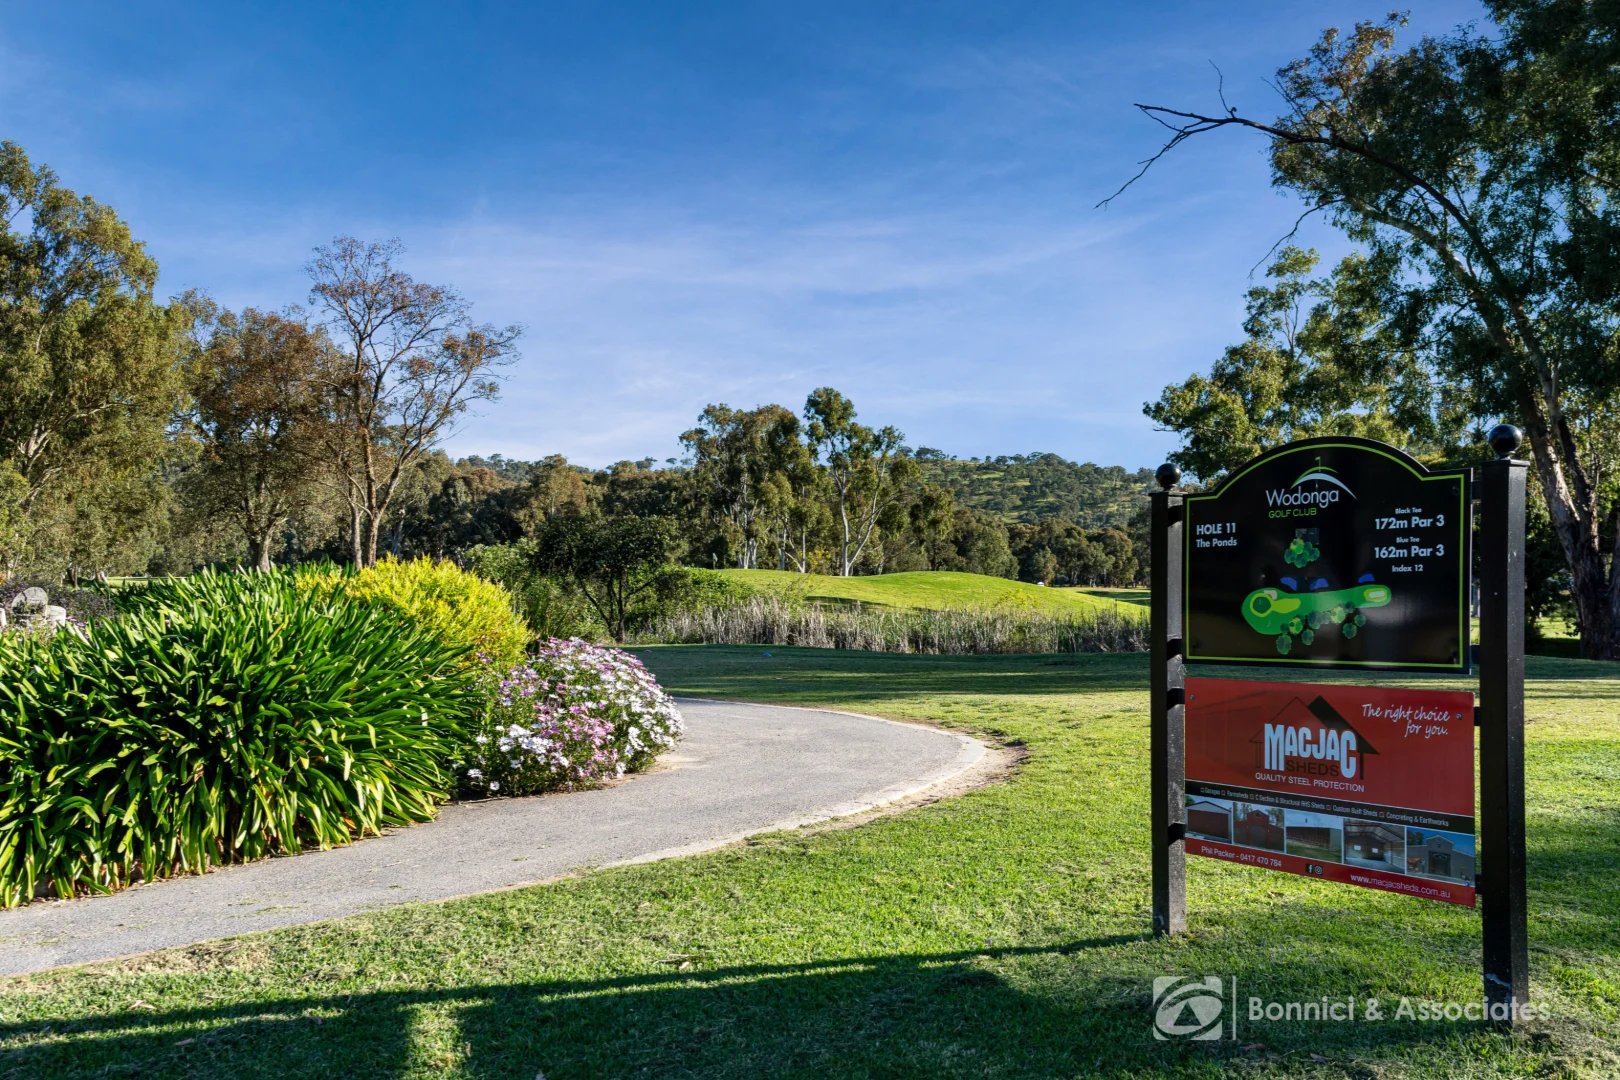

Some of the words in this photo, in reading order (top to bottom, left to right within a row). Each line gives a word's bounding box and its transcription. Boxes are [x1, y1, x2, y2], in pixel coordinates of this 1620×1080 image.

[1266, 486, 1339, 508] Wodonga
[1268, 509, 1292, 518] GOLF
[1293, 508, 1317, 517] CLUB
[1375, 517, 1408, 530] 172m
[1411, 516, 1433, 528] Par
[1436, 514, 1445, 527] 3
[1196, 523, 1222, 535] HOLE
[1226, 523, 1236, 534] 11
[1196, 539, 1210, 548] The
[1212, 537, 1237, 547] Ponds
[1374, 546, 1408, 558] 162m
[1411, 545, 1433, 557] Par
[1436, 544, 1445, 557] 3
[1392, 564, 1412, 572] Index
[1414, 564, 1423, 572] 12
[1362, 703, 1382, 717] The
[1384, 704, 1413, 723] right
[1413, 705, 1450, 721] choice
[1404, 719, 1422, 738] for
[1424, 725, 1448, 739] you.
[1264, 723, 1356, 778] MACJAC
[1286, 760, 1339, 777] SHEDS
[1255, 772, 1286, 783] QUALITY
[1288, 776, 1311, 786] STEEL
[1313, 779, 1365, 792] PROTECTION
[1260, 794, 1275, 803] Section
[1280, 797, 1300, 807] Structural
[1311, 801, 1325, 810] Sheds
[1332, 805, 1350, 814] Custom
[1351, 808, 1362, 816] Built
[1363, 808, 1378, 818] Sheds
[1386, 811, 1413, 824] Concreting
[1414, 815, 1418, 823] &
[1419, 816, 1449, 827] Earthworks
[1201, 845, 1213, 854] Phil
[1213, 848, 1235, 859] Packer
[1240, 853, 1255, 863] 0417
[1257, 856, 1268, 865] 470
[1270, 858, 1282, 867] 784
[1350, 874, 1451, 898] www.macjacsheds.com.au
